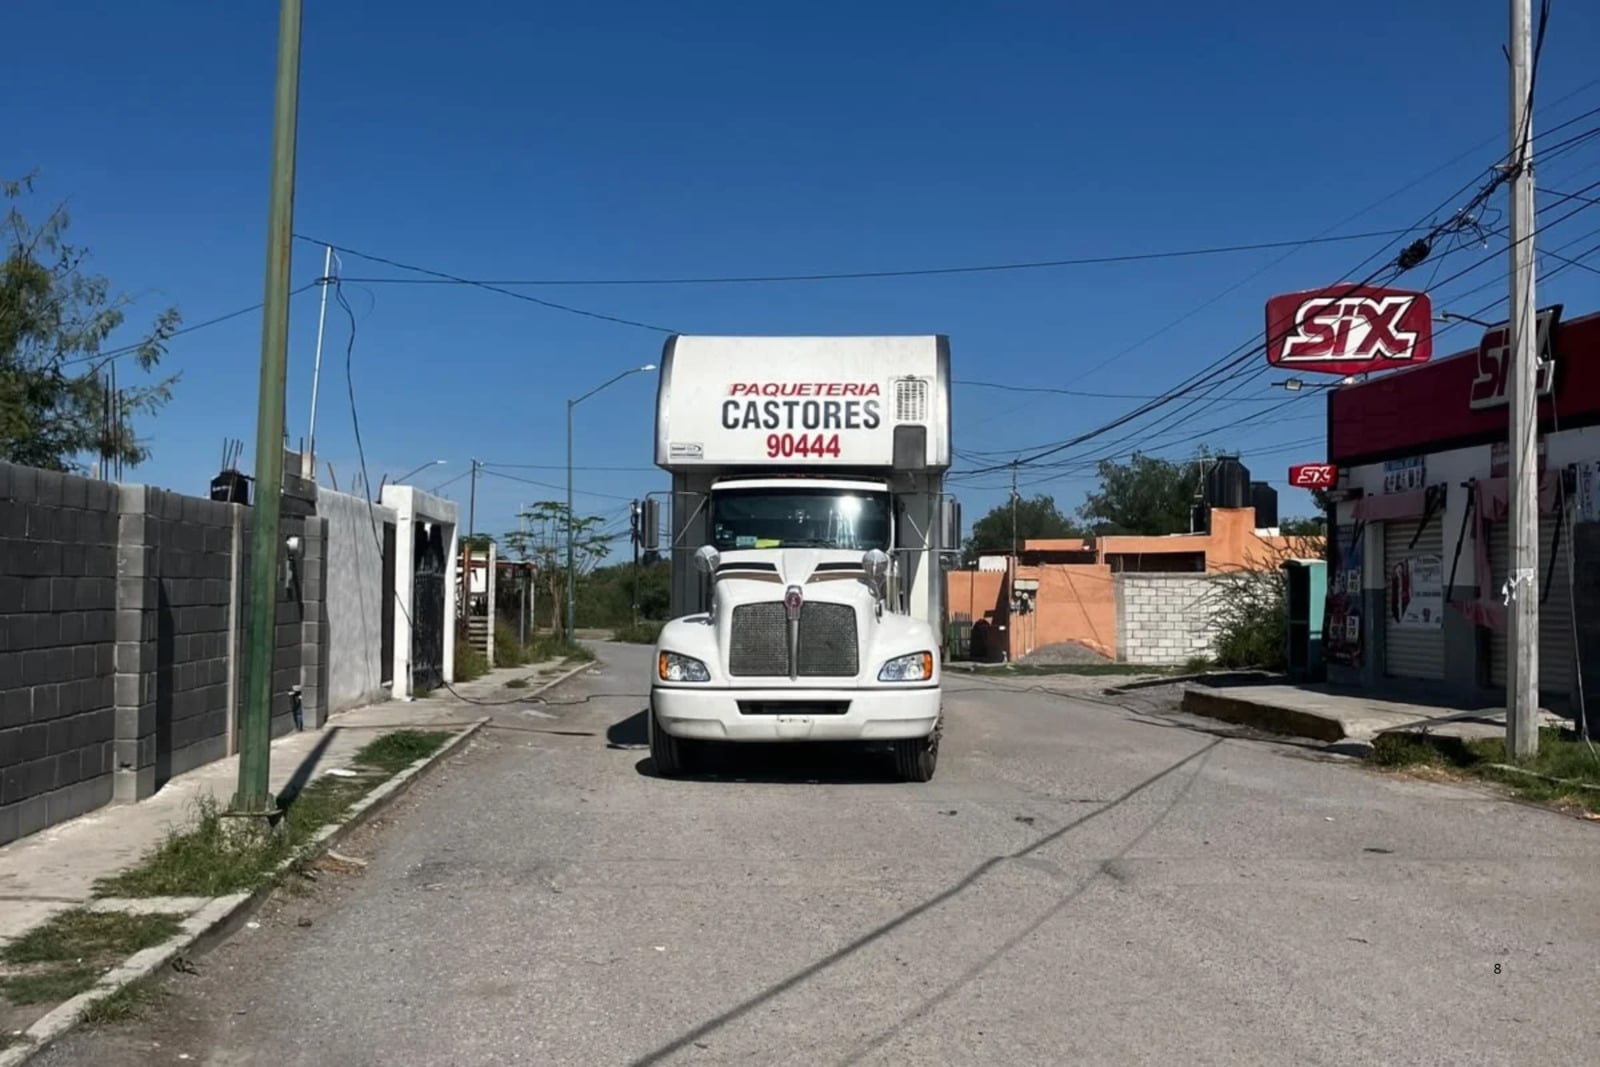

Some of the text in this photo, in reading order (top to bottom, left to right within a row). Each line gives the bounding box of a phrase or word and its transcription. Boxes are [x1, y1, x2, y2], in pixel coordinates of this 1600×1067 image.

[730, 383, 881, 397] PAQUETERIA
[722, 400, 880, 429] CASTORES
[766, 433, 841, 458] 90444
